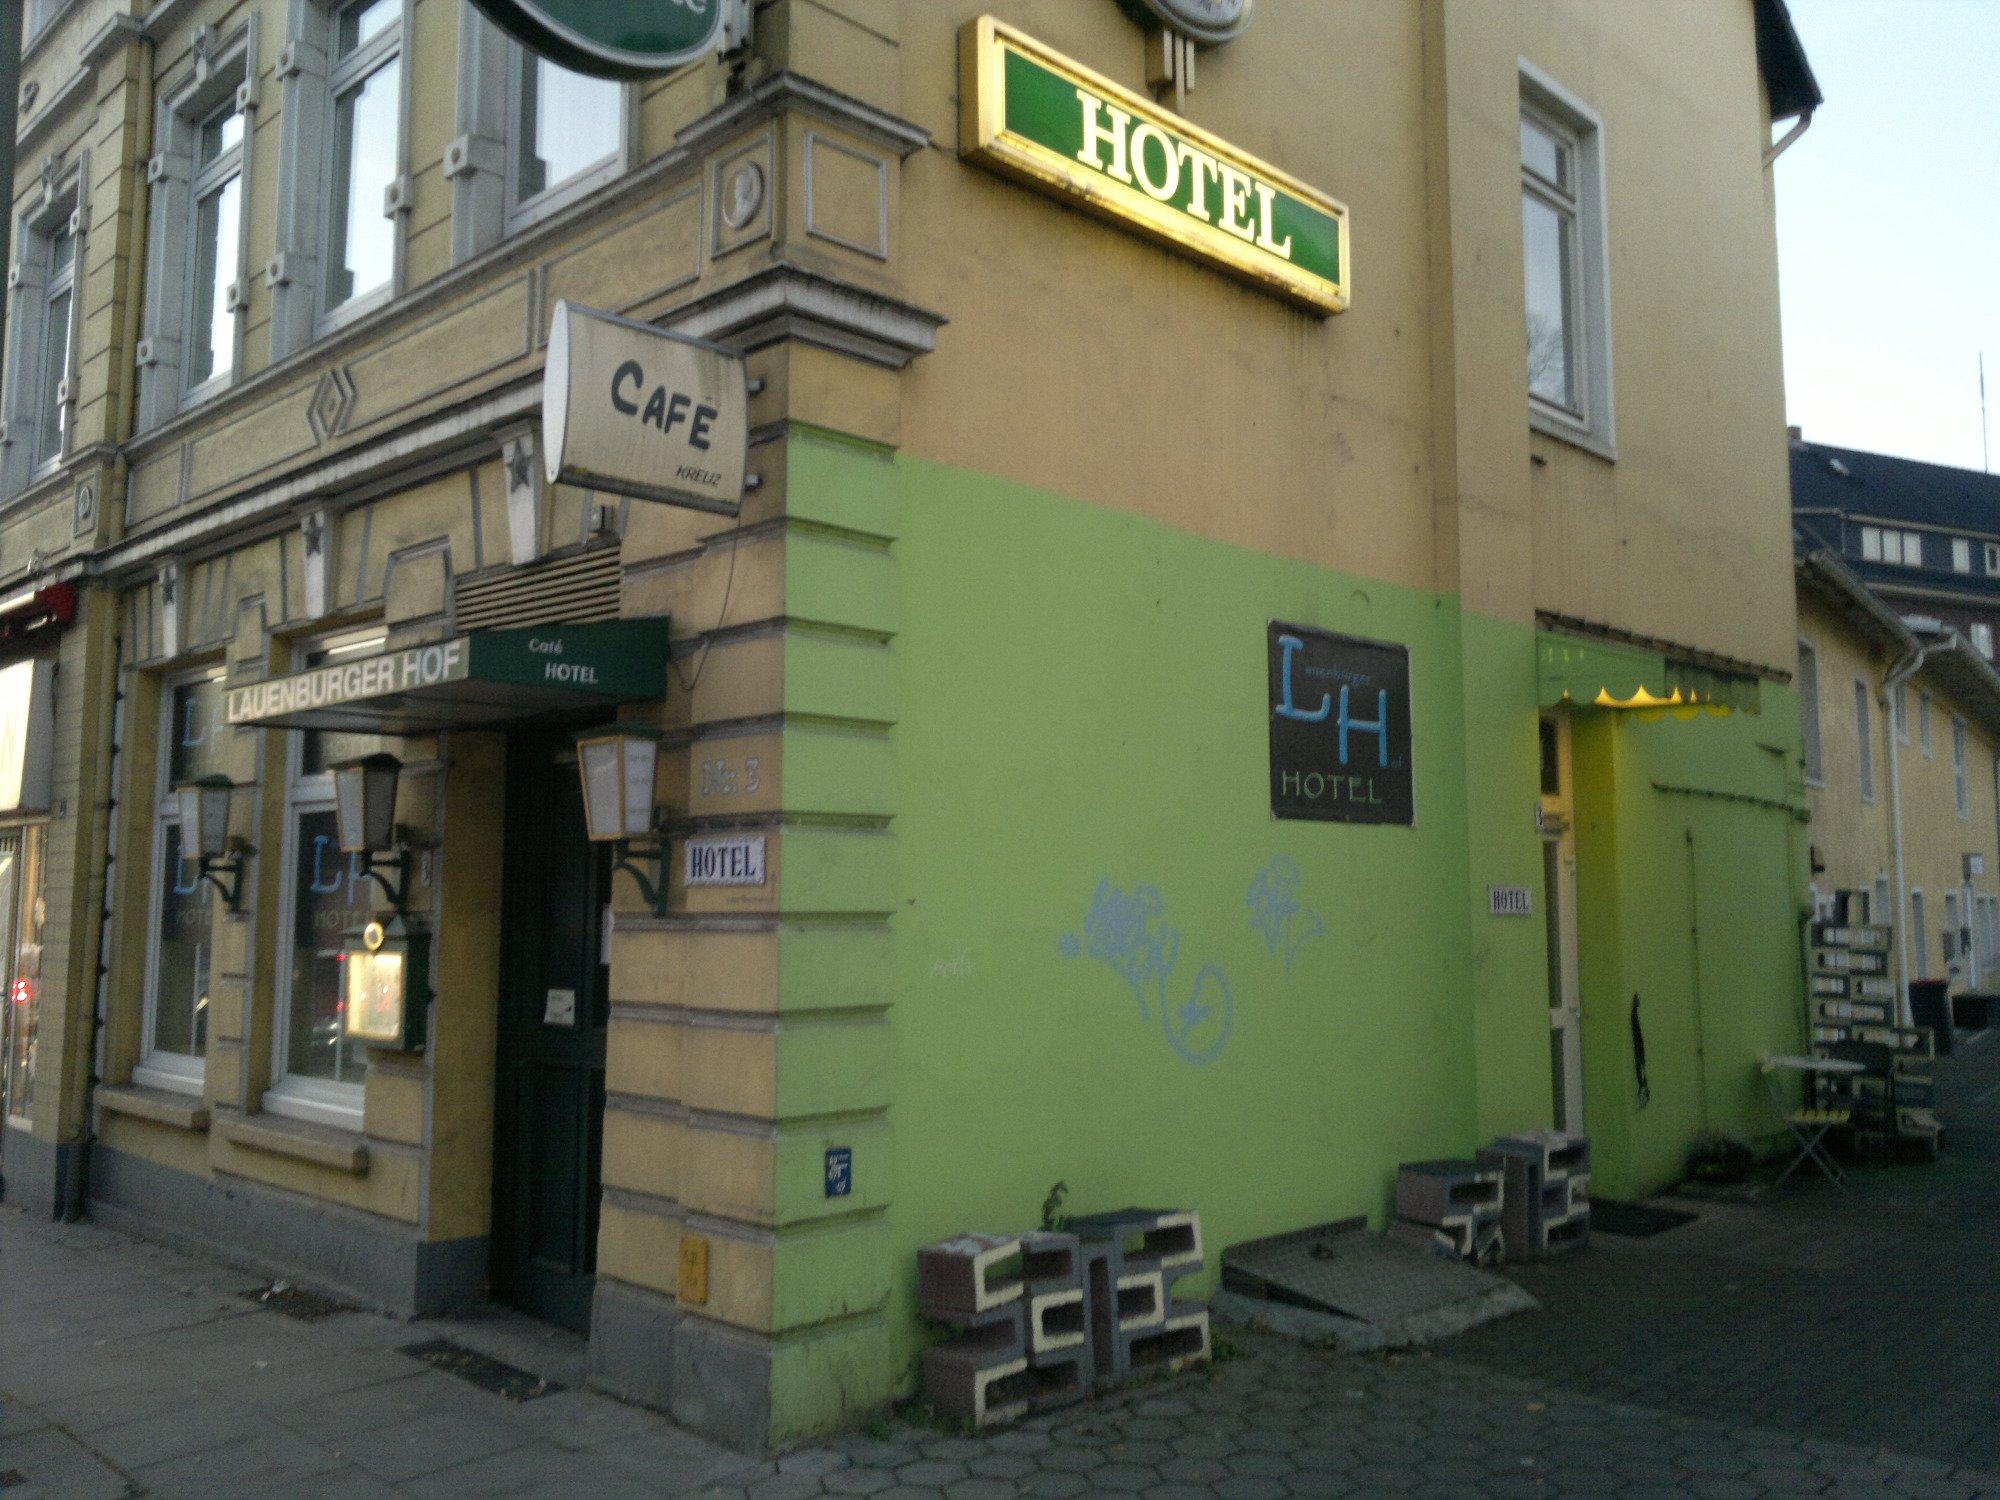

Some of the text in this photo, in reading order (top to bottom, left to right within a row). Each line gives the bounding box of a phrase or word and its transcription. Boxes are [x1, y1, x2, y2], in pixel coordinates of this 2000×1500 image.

[1077, 88, 1291, 260] HOTEL
[228, 642, 461, 722] LAUENBURGER HOF
[545, 663, 599, 685] HOTEL
[1281, 770, 1384, 804] HOTEL
[692, 845, 756, 877] HOTEL
